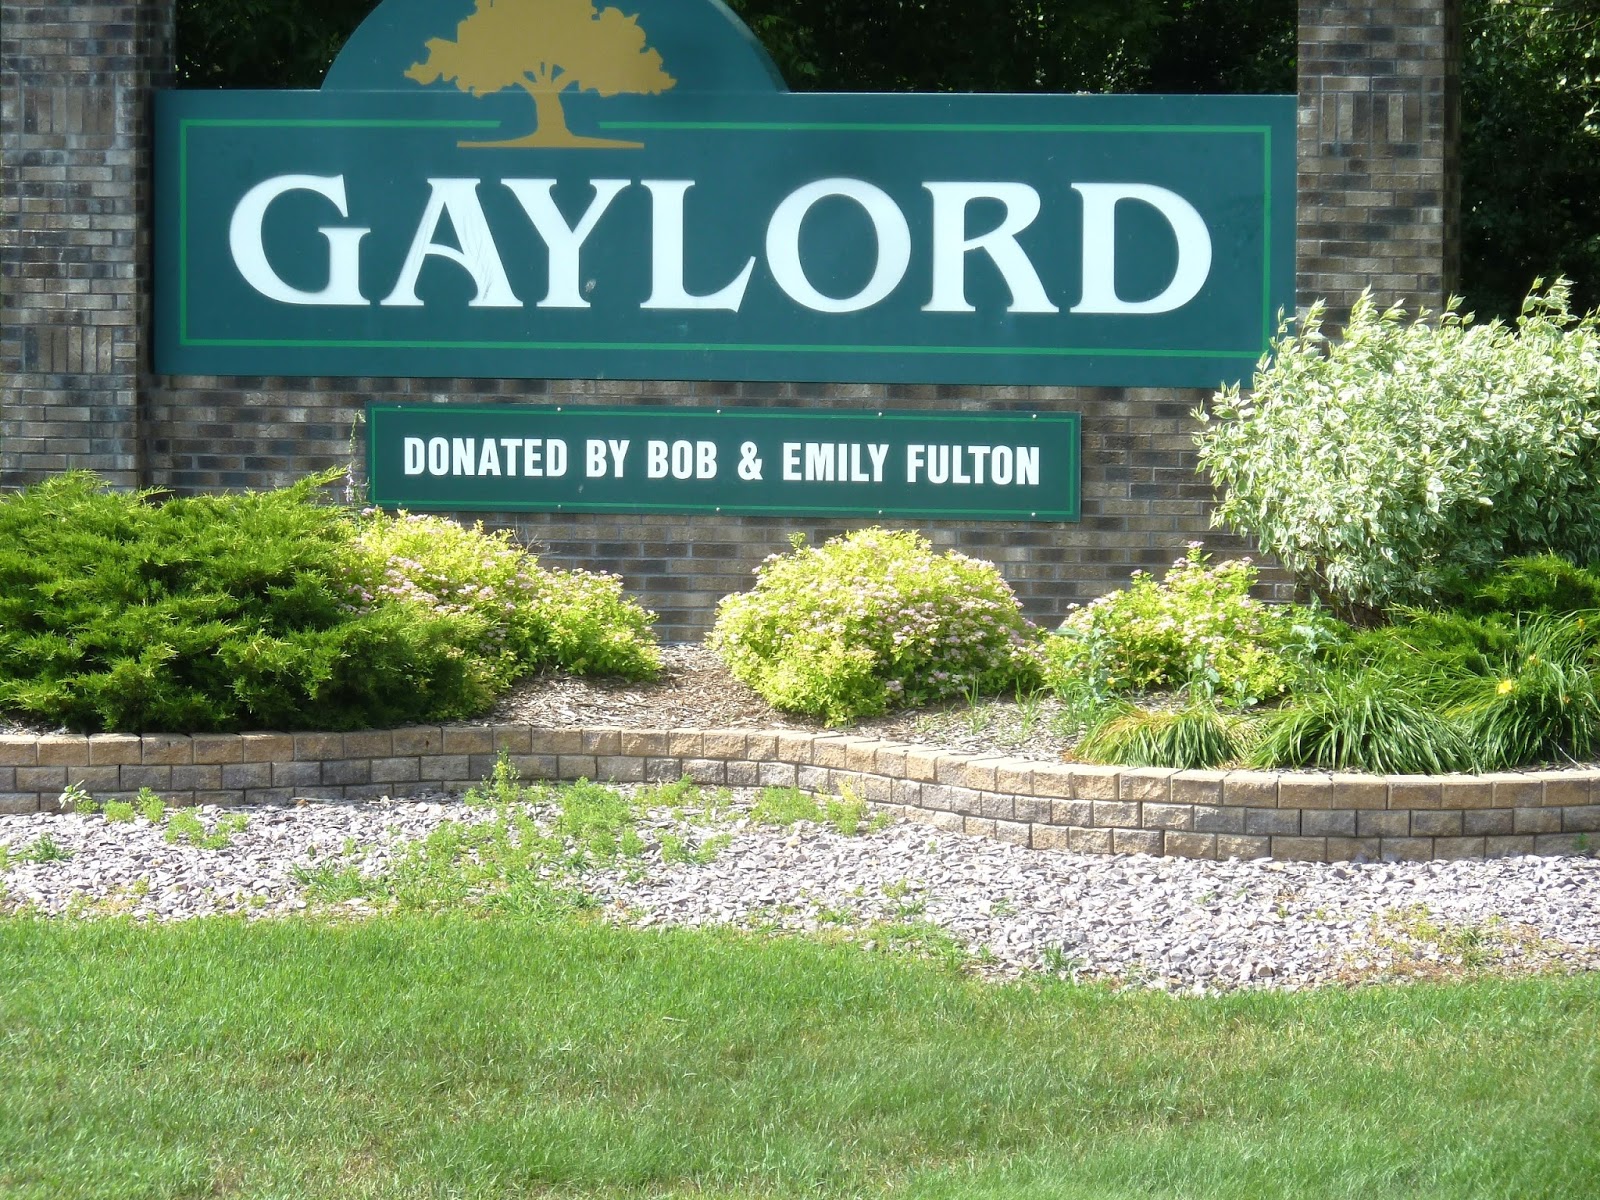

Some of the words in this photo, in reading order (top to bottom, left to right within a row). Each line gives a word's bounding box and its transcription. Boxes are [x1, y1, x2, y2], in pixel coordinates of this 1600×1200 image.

[229, 174, 1213, 315] GAYLORD
[403, 436, 569, 477] DONATED
[585, 439, 630, 479] BY
[646, 439, 719, 480] BOB
[737, 440, 764, 482] &
[781, 442, 890, 483] EMILY
[906, 444, 1041, 486] FULTON
